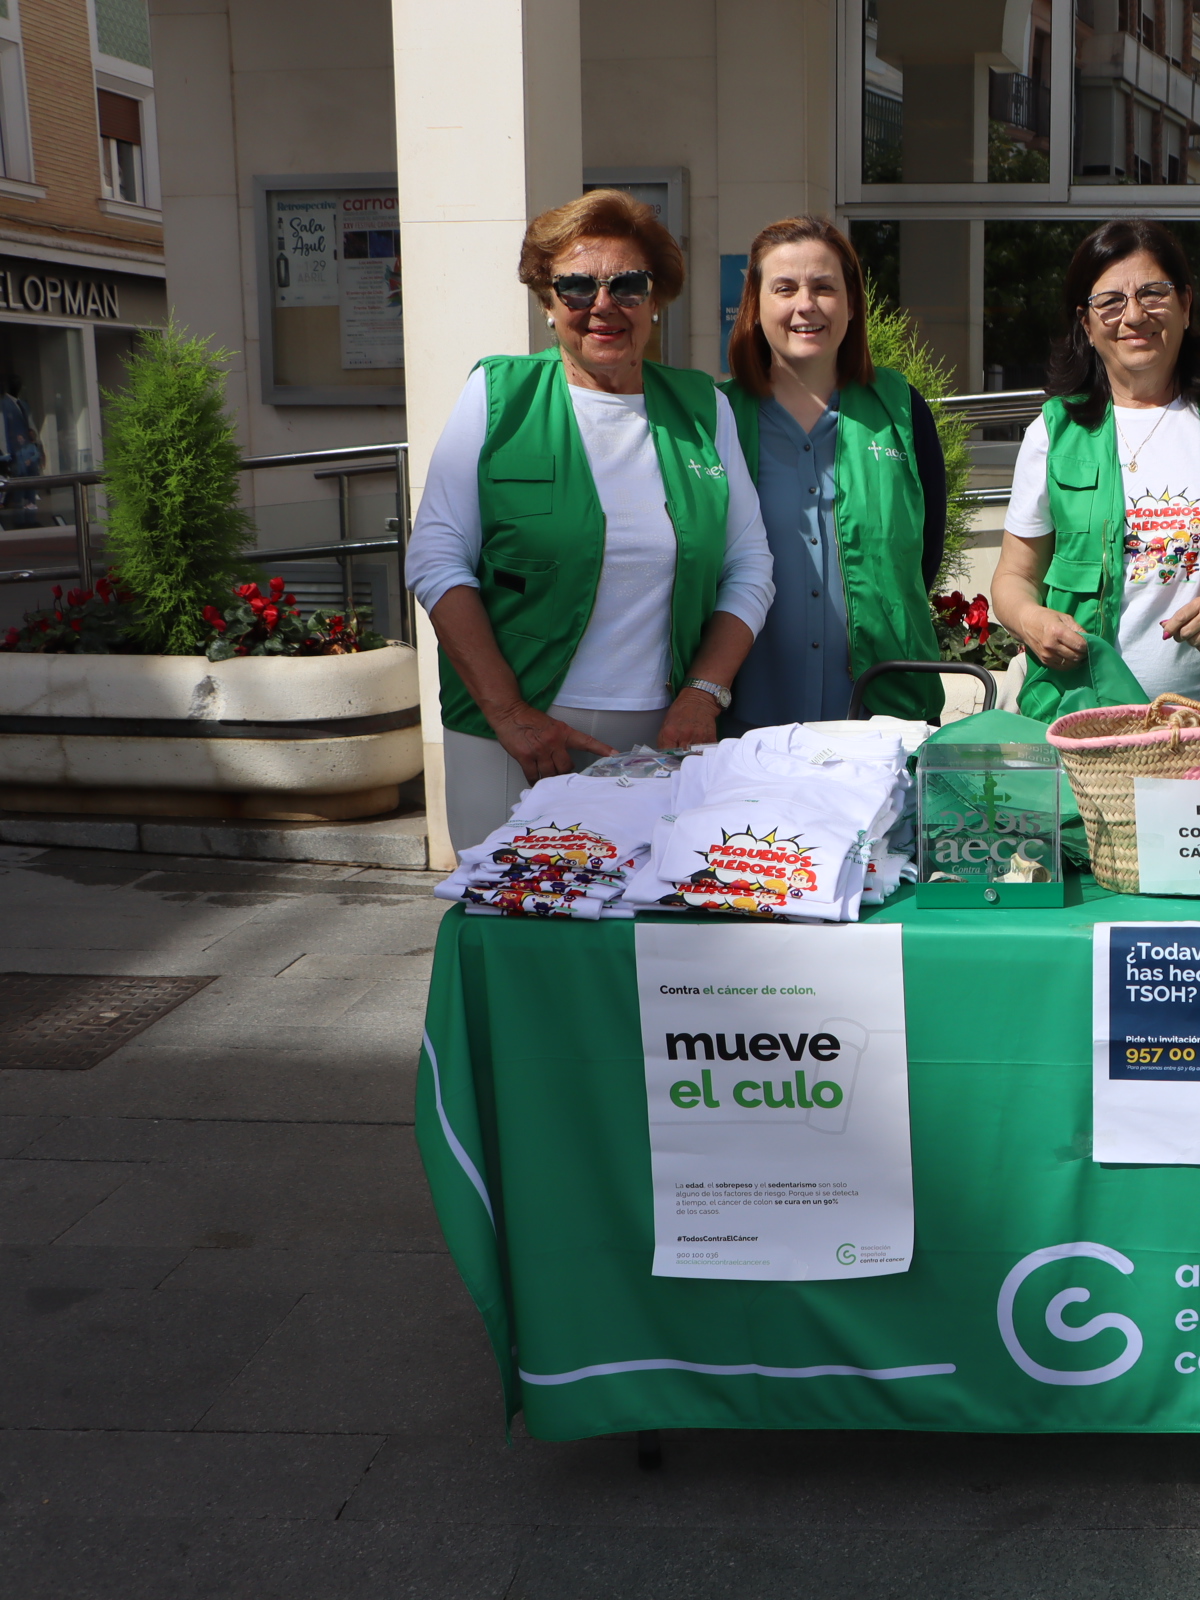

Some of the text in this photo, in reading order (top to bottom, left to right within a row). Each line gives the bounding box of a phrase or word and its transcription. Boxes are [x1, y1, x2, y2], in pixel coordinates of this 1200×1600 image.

[277, 201, 336, 212] Retrospectiva
[290, 217, 325, 237] Sala
[292, 236, 326, 256] Azul
[313, 261, 326, 271] 29
[298, 271, 326, 282] ABRIL
[709, 844, 813, 867] PEQUEÑOS
[935, 839, 1044, 863] aecc
[952, 865, 980, 874] Contra
[1127, 964, 1163, 981] has
[660, 985, 816, 996] Contra el cáncer de colon,
[1126, 986, 1197, 1003] TSOH?
[665, 1032, 841, 1061] mueve
[1126, 1048, 1164, 1063] 957
[1169, 1048, 1195, 1061] 00
[669, 1069, 843, 1109] el culo
